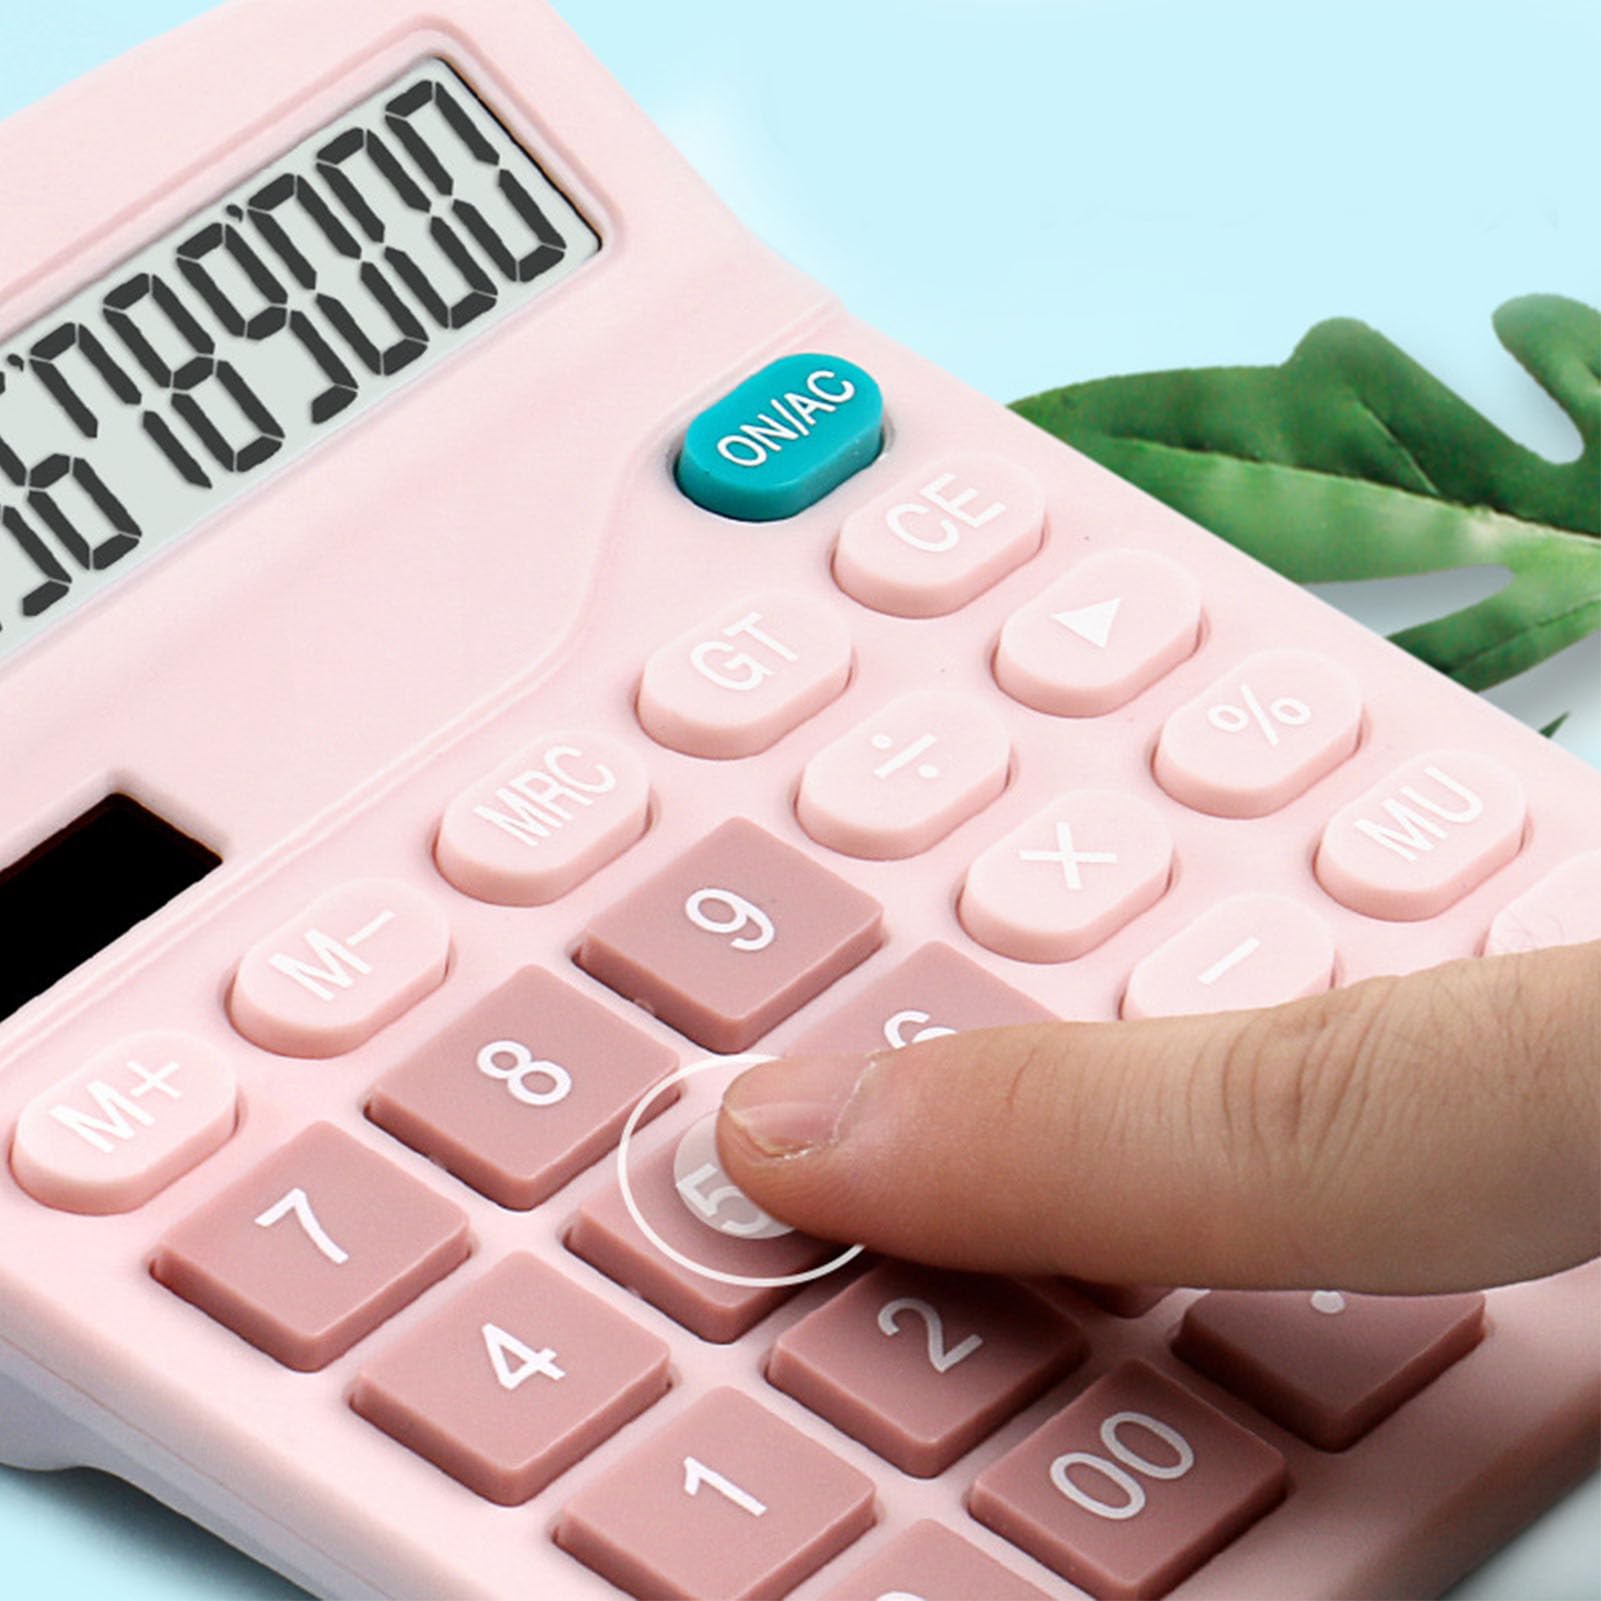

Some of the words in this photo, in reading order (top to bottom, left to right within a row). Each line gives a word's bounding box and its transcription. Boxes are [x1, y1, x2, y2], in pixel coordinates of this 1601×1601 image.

[716, 370, 856, 469] ON/AC
[885, 473, 1006, 552] CE
[690, 612, 799, 690] GT
[1206, 683, 1312, 746] %
[474, 745, 616, 847] MRC
[1353, 766, 1483, 862] MU
[685, 888, 775, 951] 9
[49, 1060, 182, 1153] M+
[477, 1040, 572, 1105] 8
[255, 1188, 349, 1264] 7
[482, 1323, 566, 1390] 4
[877, 1298, 984, 1374] 2
[684, 1456, 767, 1516] 1
[1049, 1411, 1194, 1521] 00
